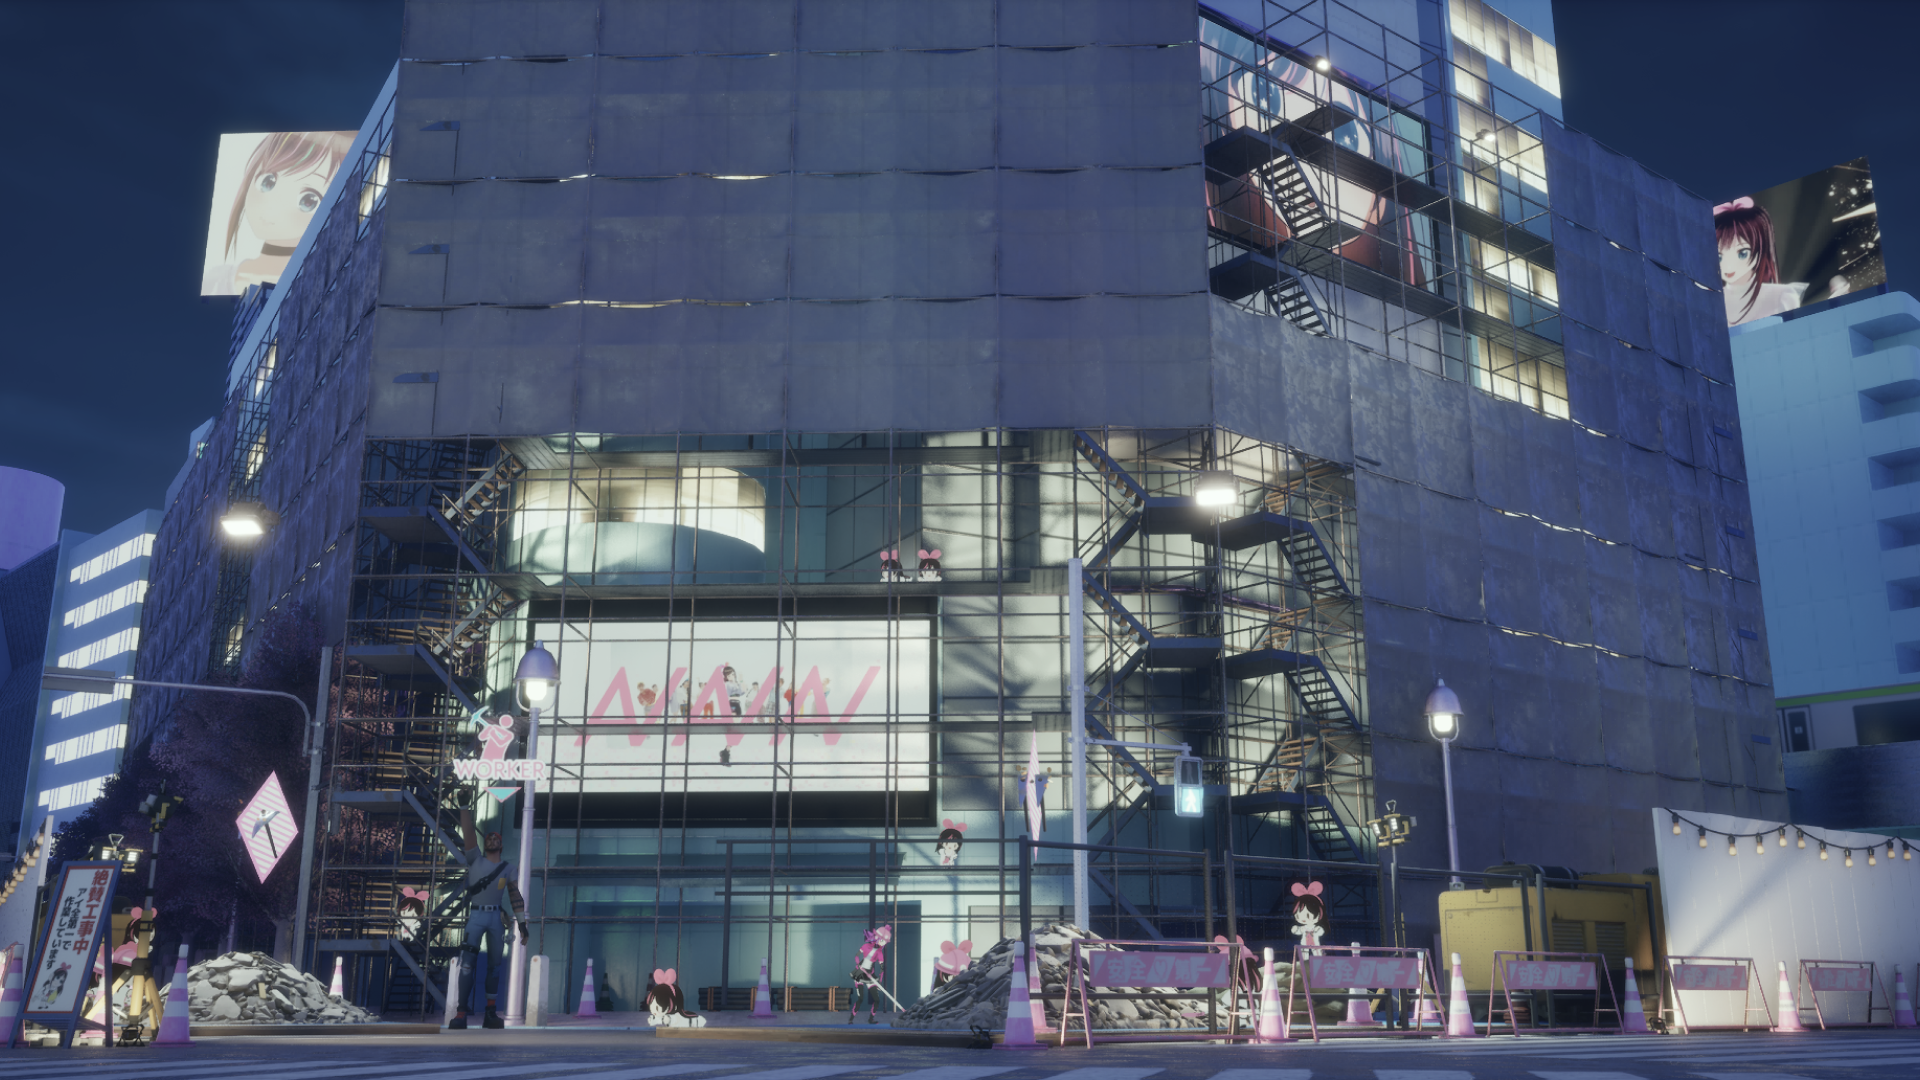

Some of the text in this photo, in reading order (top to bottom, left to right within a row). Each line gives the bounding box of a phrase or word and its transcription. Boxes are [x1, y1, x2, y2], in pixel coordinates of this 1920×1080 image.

[454, 760, 546, 779] WORKER
[46, 896, 75, 970] 作業しています
[62, 887, 87, 950] アイ全第一で
[72, 870, 110, 955] 絶賛工事中
